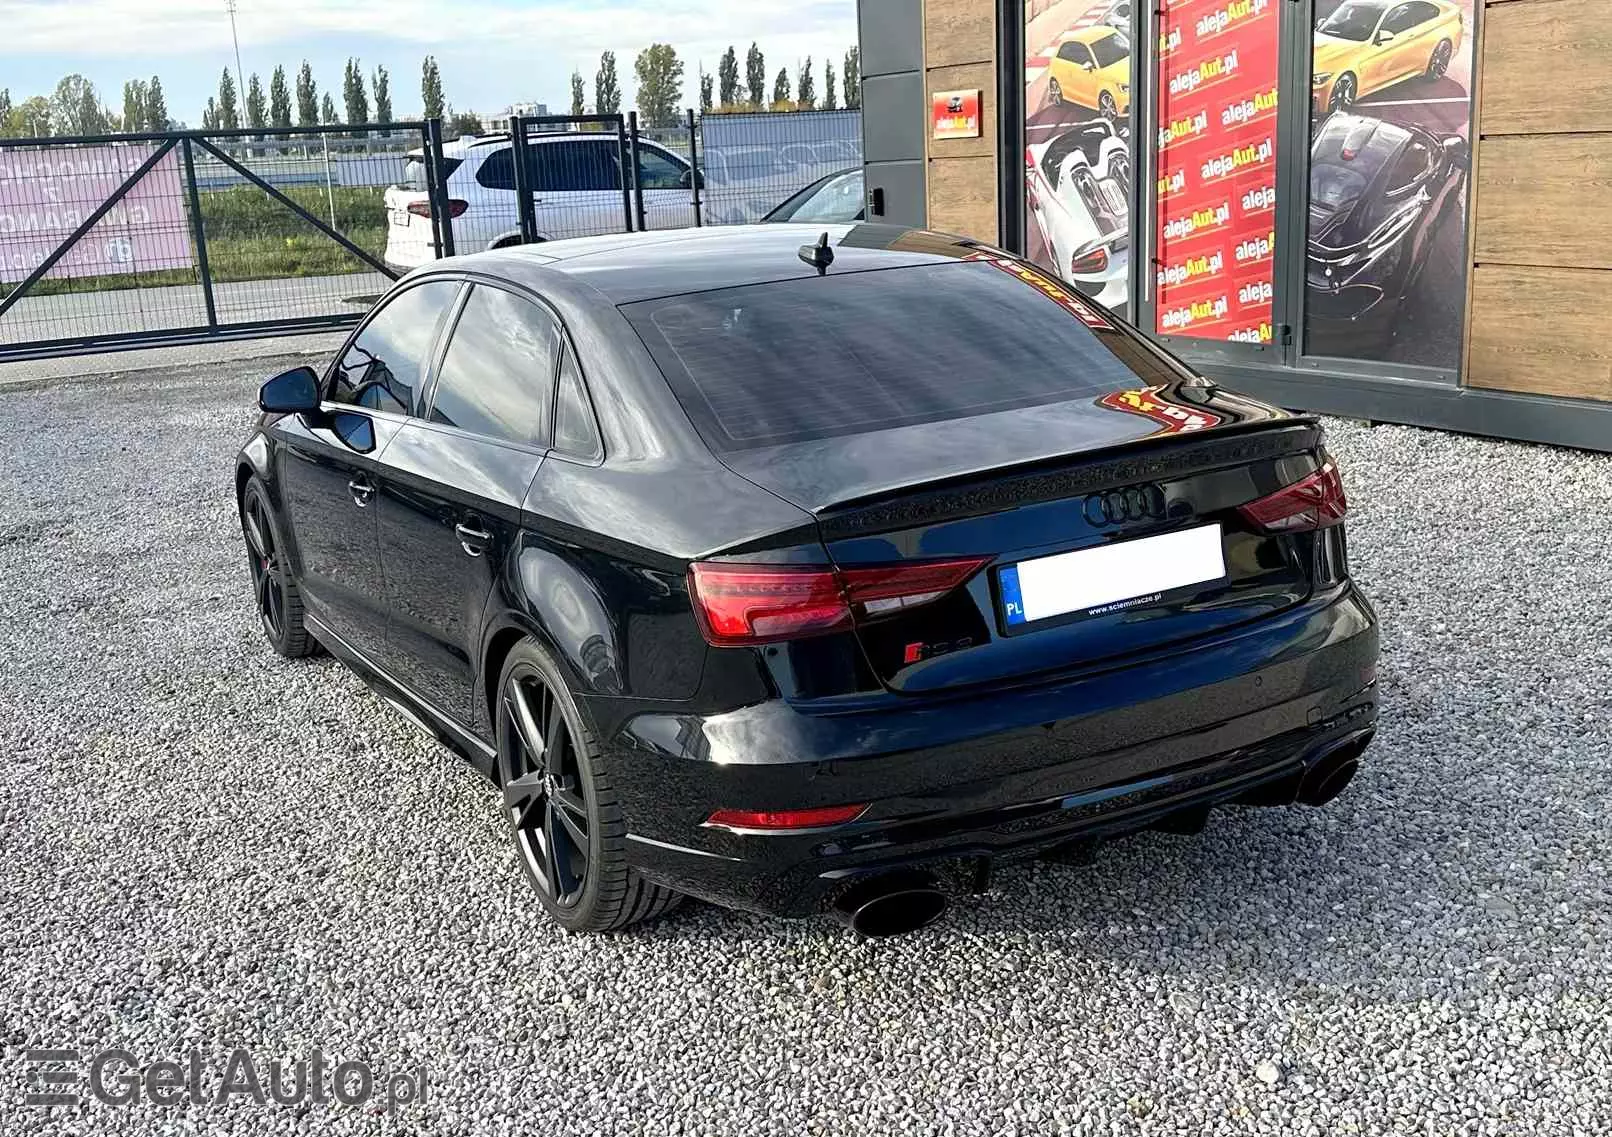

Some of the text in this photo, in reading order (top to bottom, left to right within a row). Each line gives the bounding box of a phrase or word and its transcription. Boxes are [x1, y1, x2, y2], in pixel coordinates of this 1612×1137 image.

[1170, 49, 1238, 95] alejaAut.pl
[1222, 88, 1278, 125] alejaAut
[1201, 138, 1272, 179] alejaAut.pl
[1242, 186, 1275, 210] aleja
[1163, 202, 1229, 239] alejaAut.pl
[1157, 250, 1223, 286] alejaAut.pl
[1239, 281, 1272, 303] aleja
[1162, 296, 1228, 328] alejaAut.pl
[1007, 602, 1023, 616] PL
[1088, 592, 1162, 616] www.sciemniacze.pl
